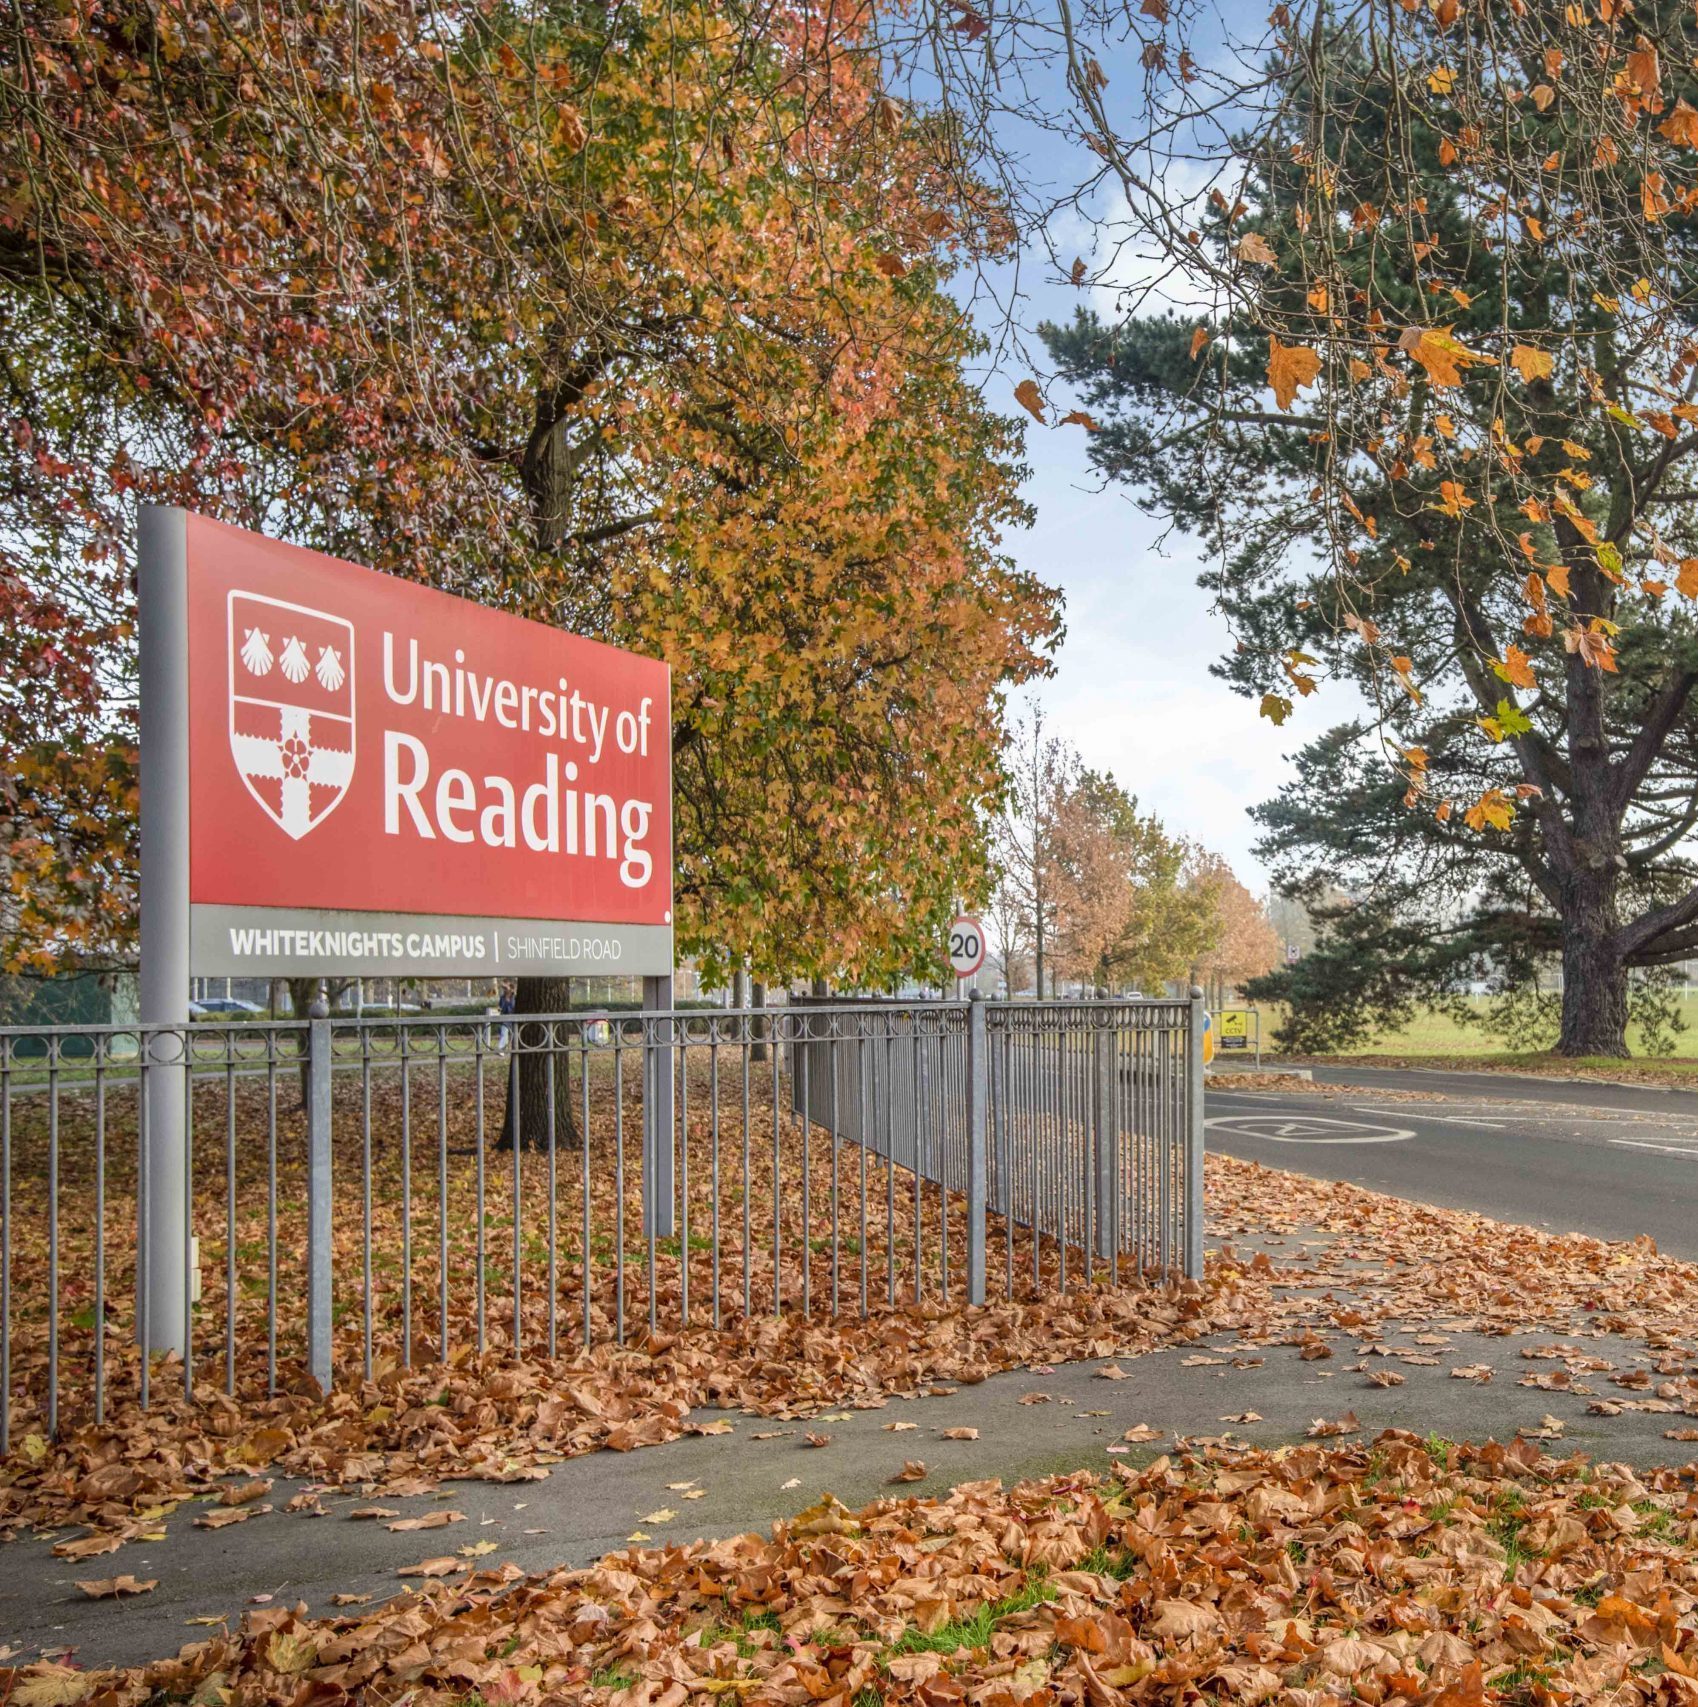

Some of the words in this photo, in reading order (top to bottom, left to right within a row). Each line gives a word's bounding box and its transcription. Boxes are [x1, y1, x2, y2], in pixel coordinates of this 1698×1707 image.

[382, 630, 609, 764] University
[615, 696, 653, 757] of
[383, 729, 653, 889] Reading
[229, 928, 404, 958] WHITEKNIGHTS
[406, 933, 486, 959] CAMPUS
[507, 936, 581, 960] SHINFIELD
[581, 938, 622, 961] ROAD
[950, 933, 979, 959] 20
